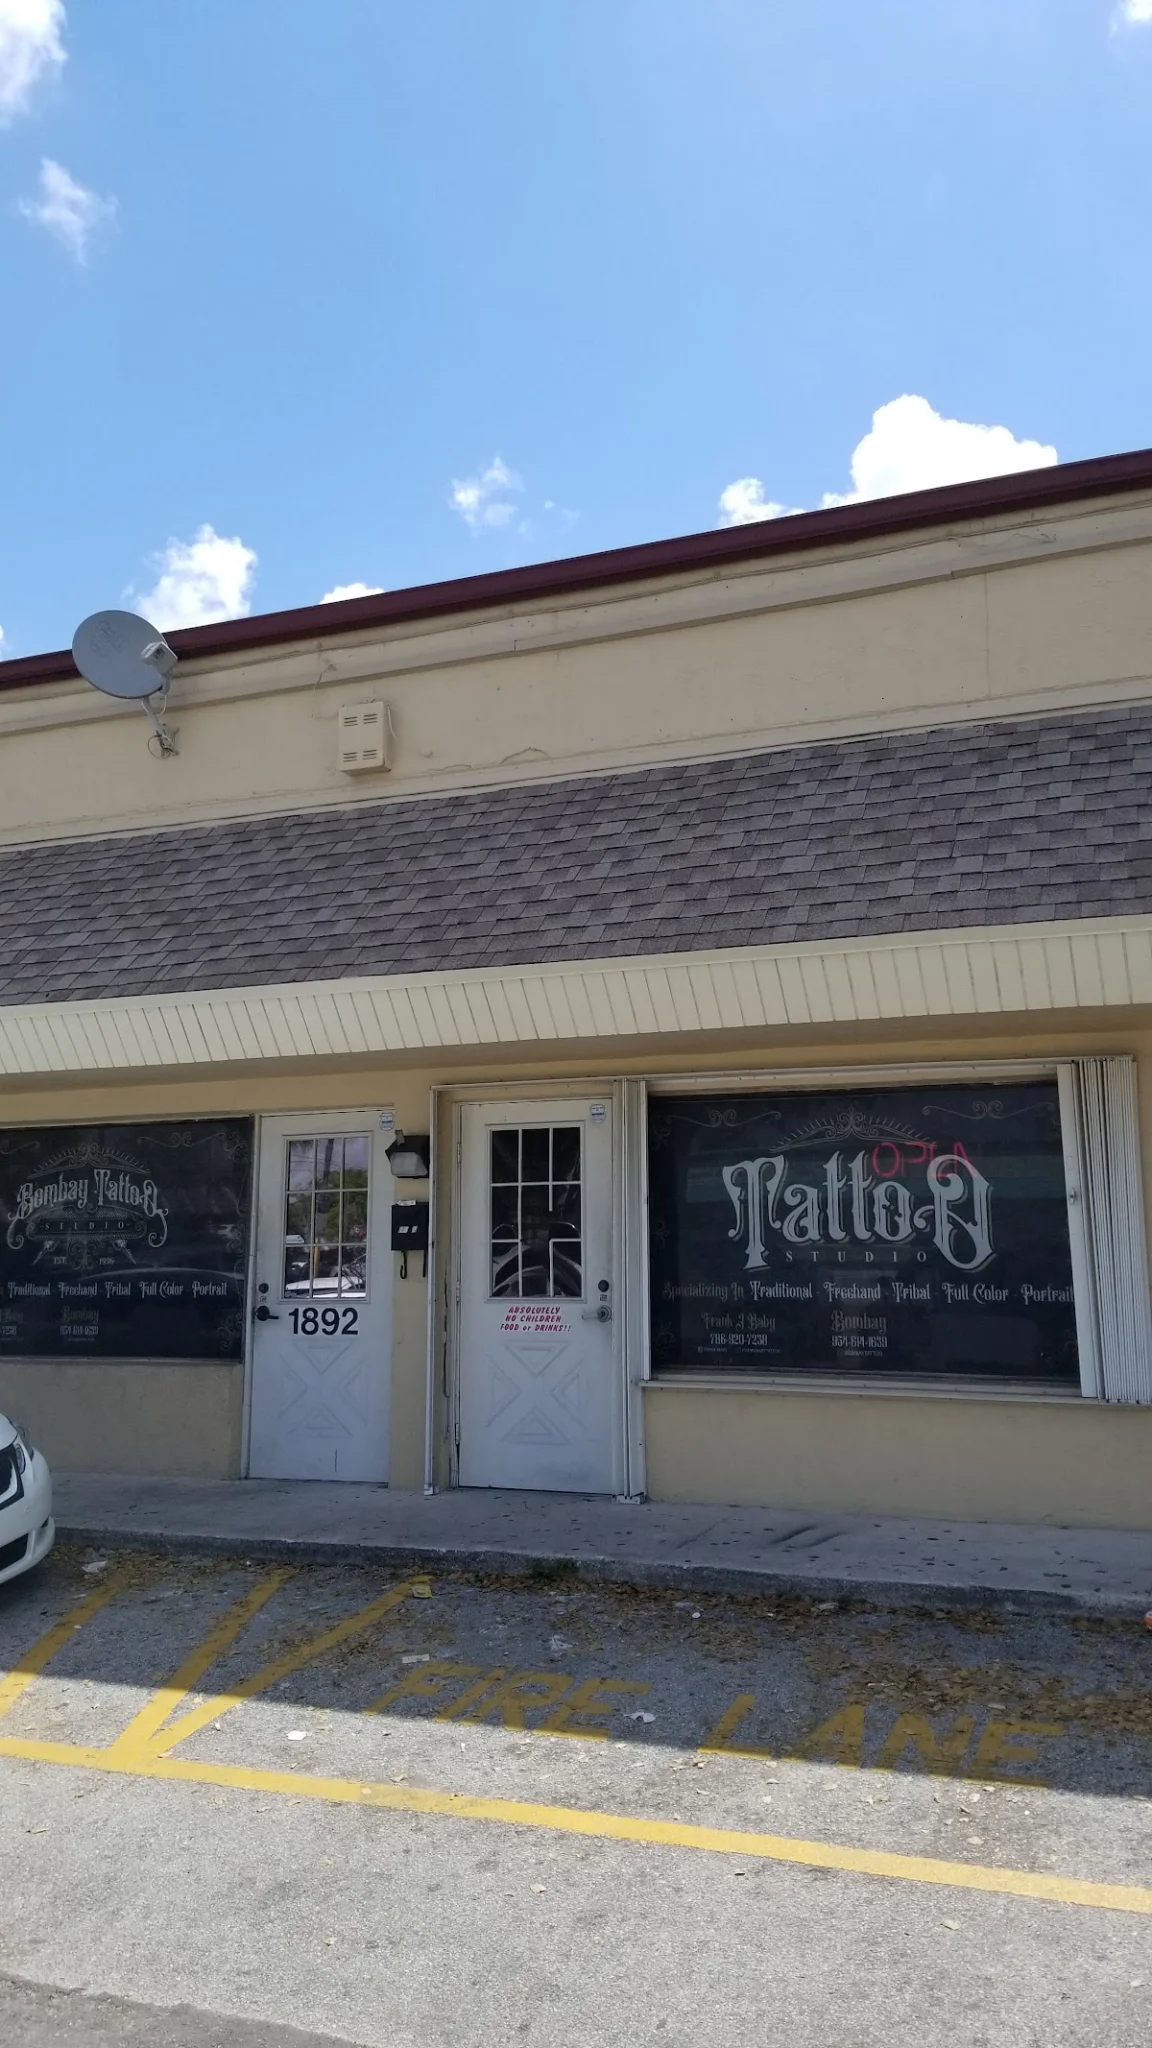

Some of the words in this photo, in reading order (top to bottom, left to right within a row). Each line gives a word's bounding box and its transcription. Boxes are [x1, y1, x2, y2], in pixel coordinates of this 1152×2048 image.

[722, 1149, 997, 1272] Tattoo
[44, 1221, 125, 1230] STUDIO
[786, 1250, 927, 1263] STUDIO
[8, 1281, 51, 1298] Traditional
[105, 1281, 131, 1298] Tribal
[139, 1281, 157, 1298] Full
[159, 1281, 184, 1298] Color
[192, 1281, 227, 1298] Portrait
[662, 1281, 728, 1303] Specializing
[750, 1281, 813, 1300] Traditional
[823, 1281, 881, 1302] Freehand
[891, 1281, 931, 1302] Tribal
[942, 1282, 970, 1304] Full
[972, 1283, 1009, 1304] Color
[1021, 1284, 1075, 1305] Portrait
[508, 1306, 561, 1314] ABSOLUTELY
[520, 1315, 562, 1323] CHILDREN
[288, 1307, 359, 1336] 1892
[500, 1323, 519, 1331] FOOD
[701, 1312, 733, 1330] Frank
[747, 1312, 776, 1332] Baby
[830, 1309, 887, 1335] Bombay
[365, 1661, 654, 1741] FIRE
[699, 1695, 1066, 1789] LANE
